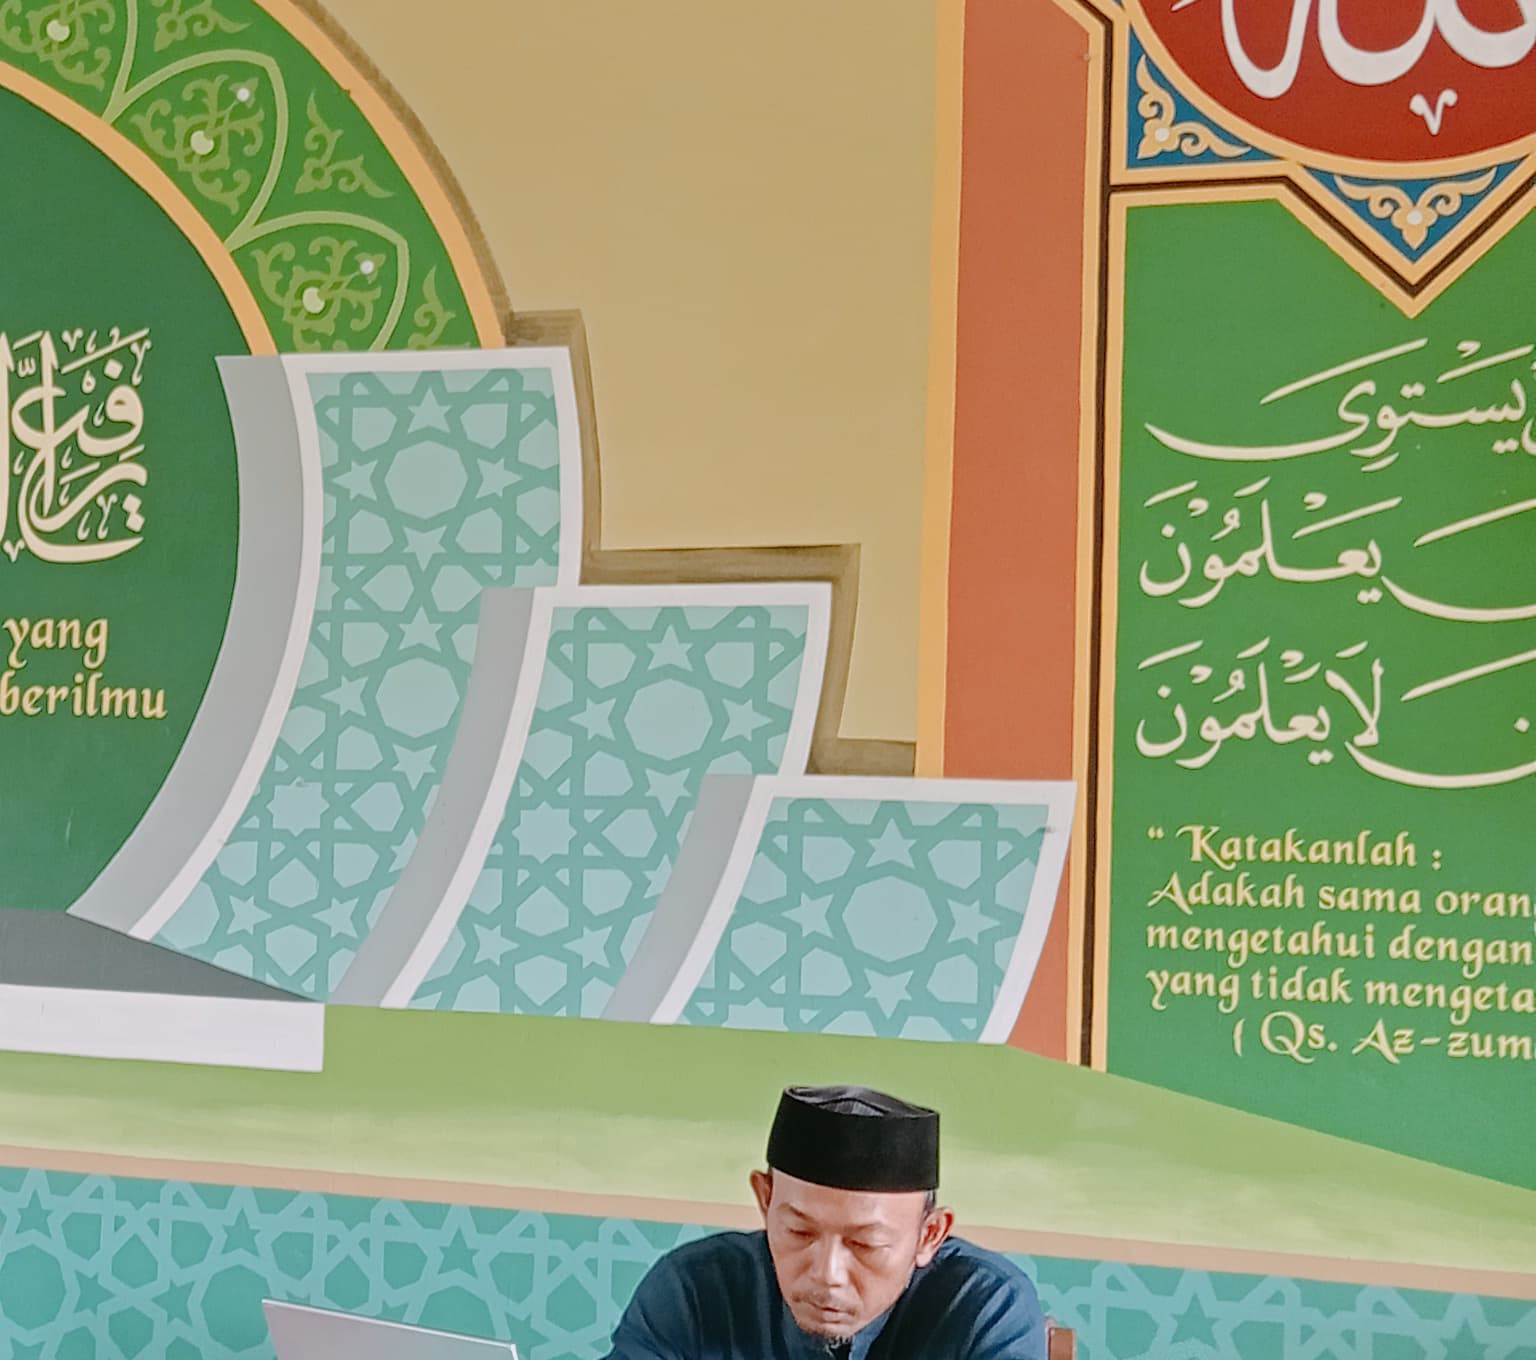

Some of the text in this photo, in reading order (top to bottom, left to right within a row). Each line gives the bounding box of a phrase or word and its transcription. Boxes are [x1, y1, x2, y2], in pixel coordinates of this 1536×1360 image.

[2, 617, 108, 669] yang
[1176, 825, 1417, 870] Katakanlah
[1147, 871, 1536, 935] Adakah sama oran
[1147, 922, 1534, 979] mengetahui dengan
[1146, 969, 1240, 1014] yang
[1252, 966, 1353, 1004] tidak
